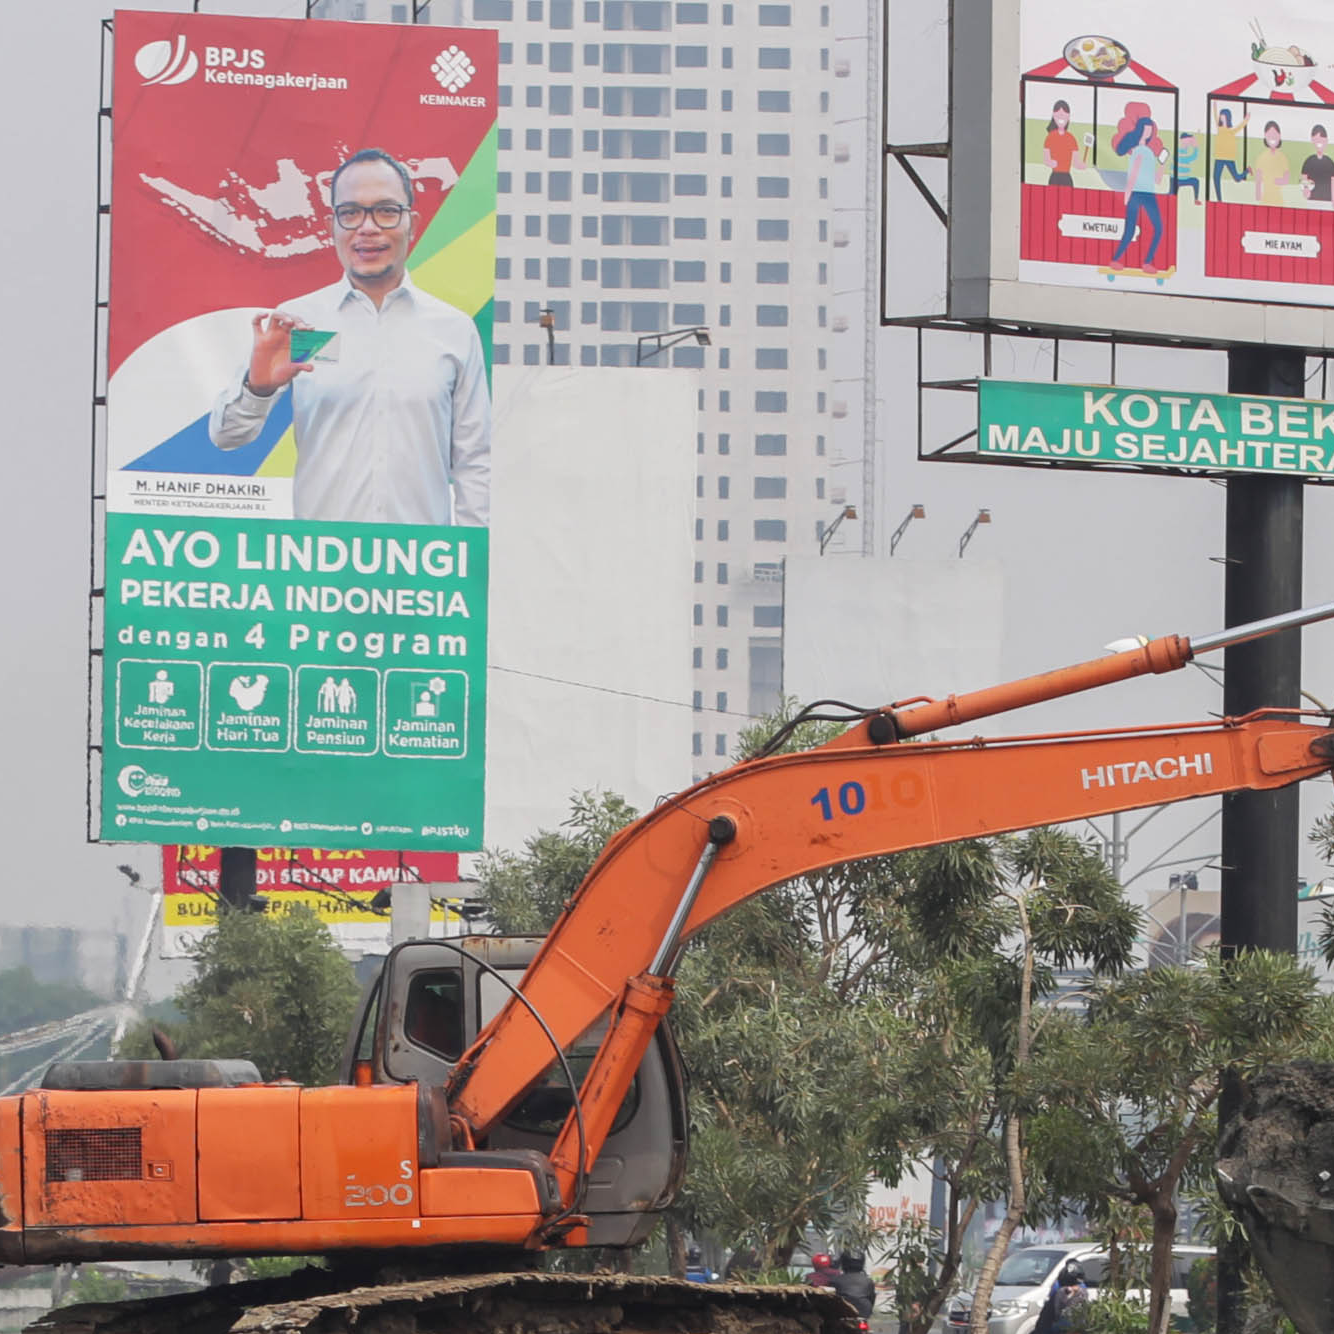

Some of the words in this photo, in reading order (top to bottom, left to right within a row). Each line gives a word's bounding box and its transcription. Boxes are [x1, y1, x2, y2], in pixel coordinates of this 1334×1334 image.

[205, 46, 265, 69] BPJS
[204, 69, 348, 91] Ketenagakerjaan
[419, 94, 486, 108] KEMNAKER
[1082, 222, 1118, 233] KWETIAU
[1265, 240, 1278, 249] MIE
[1280, 241, 1302, 251] AYAM
[1082, 390, 1227, 434] KOTA
[986, 423, 1101, 457] MAJU
[136, 480, 151, 492] M.
[156, 481, 201, 494] HANIF
[205, 483, 266, 497] DHAKIRI
[121, 528, 220, 569] AYO
[237, 532, 468, 578] LINDUNGI
[120, 579, 275, 611] PEKERJA
[285, 585, 470, 619] INDONESIA
[118, 625, 228, 650] dengan
[245, 623, 265, 650] 4
[289, 624, 468, 659] Program
[134, 704, 187, 717] Jaminan
[216, 712, 281, 727] Jaminan
[305, 715, 368, 731] Jaminan
[393, 719, 455, 733] Jaminan
[143, 730, 176, 744] Kerja
[217, 728, 247, 742] Hari
[252, 728, 280, 742] Tua
[307, 731, 366, 745] Pensiun
[389, 733, 460, 749] Kematian
[1080, 752, 1213, 790] HITACHI
[811, 781, 865, 821] 10
[280, 867, 345, 884] SETIAP
[349, 866, 420, 883] KAMAR
[400, 1159, 413, 1179] S
[345, 1183, 413, 1207] 200
